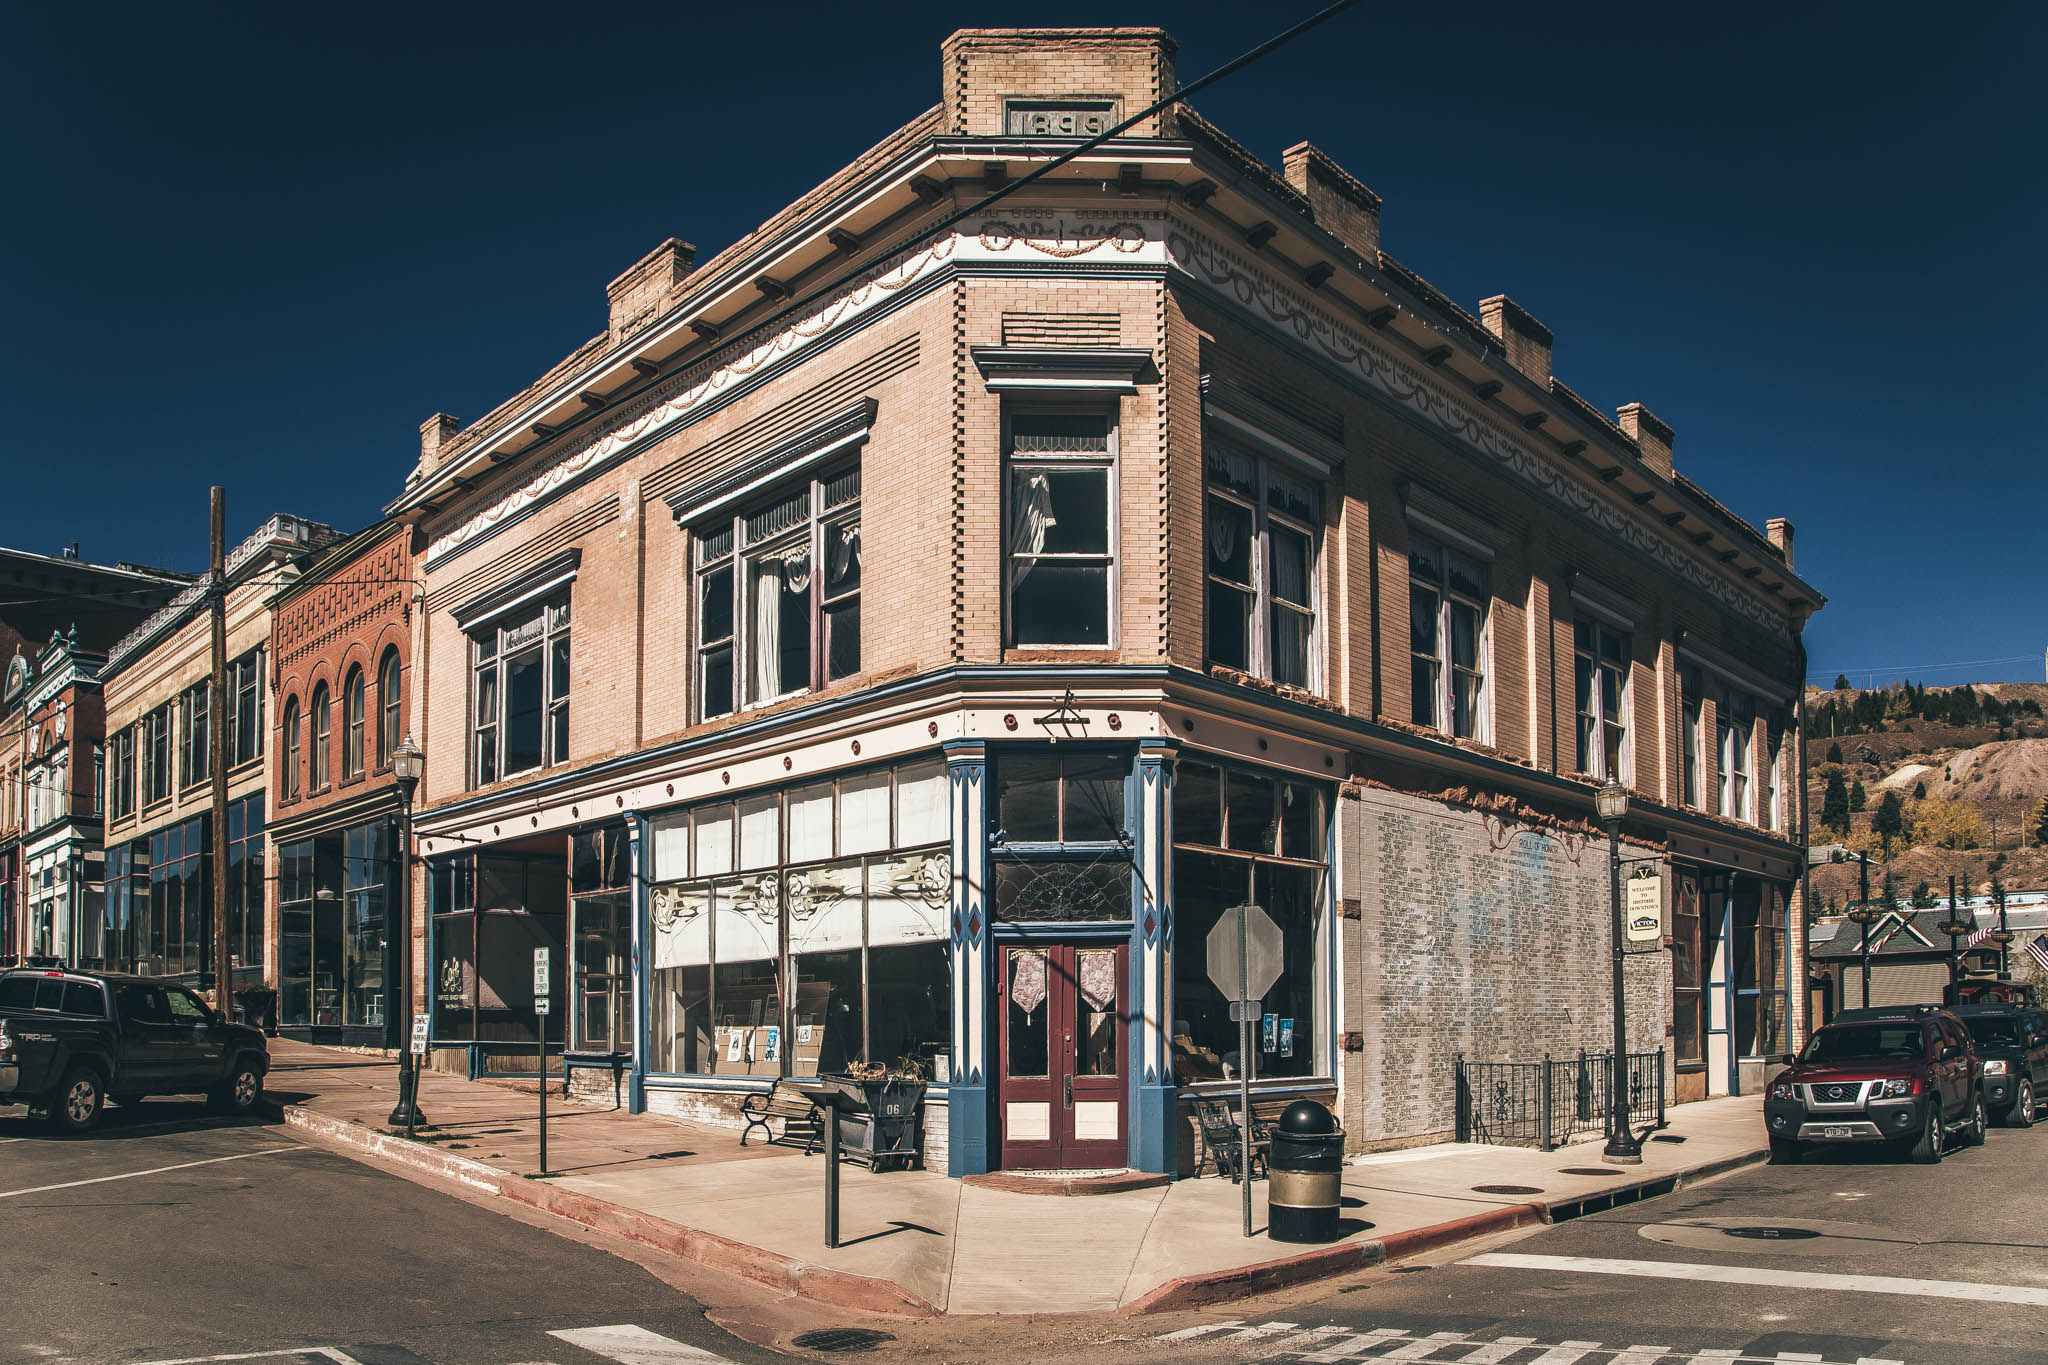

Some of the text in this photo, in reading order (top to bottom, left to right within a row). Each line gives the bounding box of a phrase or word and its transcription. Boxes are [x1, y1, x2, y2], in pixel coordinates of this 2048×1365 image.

[1519, 838, 1559, 854] ROLL OF HONOR
[1638, 868, 1650, 879] V
[886, 1104, 900, 1115] 06
